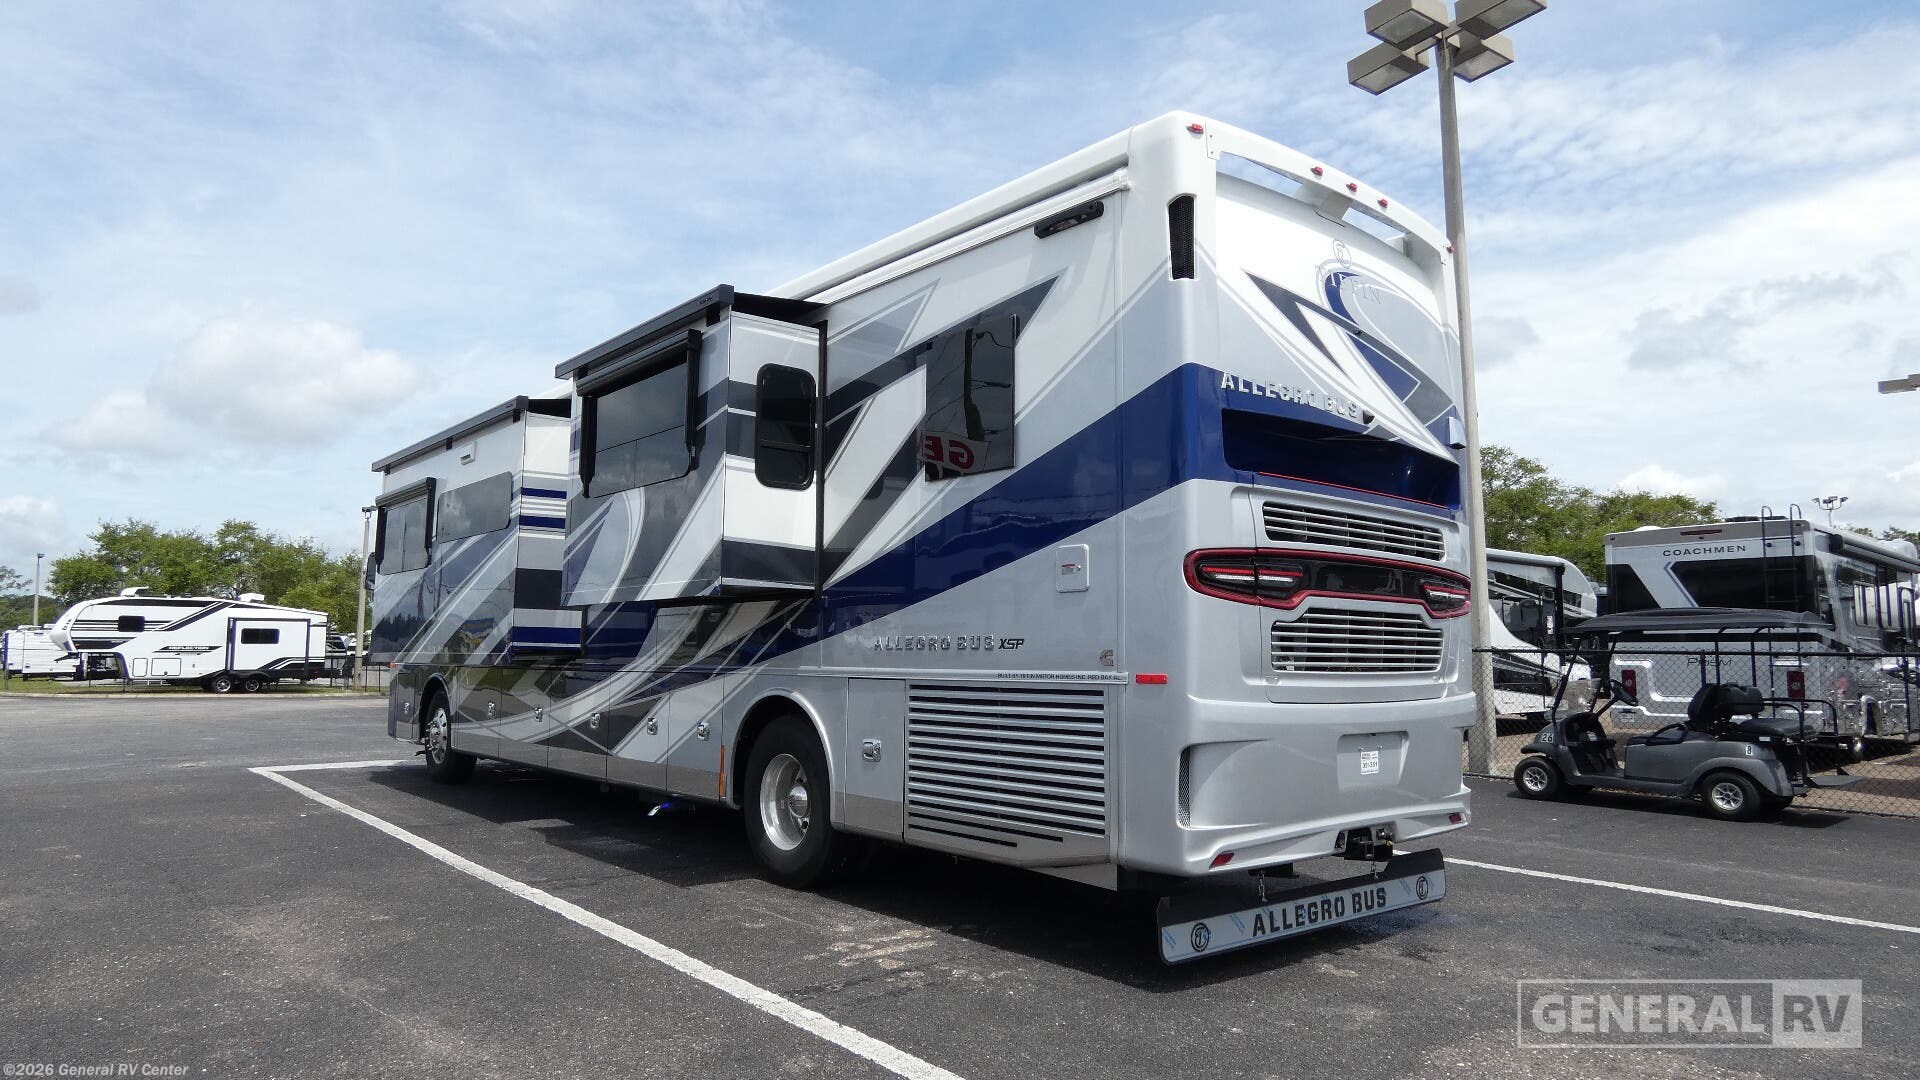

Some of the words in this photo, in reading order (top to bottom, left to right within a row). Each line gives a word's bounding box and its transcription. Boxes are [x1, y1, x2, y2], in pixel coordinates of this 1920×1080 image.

[1221, 371, 1317, 407] ALLEGRO
[1324, 393, 1358, 418] BUS
[1662, 545, 1747, 557] COACHMEN
[874, 634, 951, 651] ALLEGRO
[957, 634, 995, 651] BUS
[998, 638, 1025, 650] XSP
[1542, 733, 1553, 743] 26
[1253, 896, 1345, 937] ALLEGRO
[1352, 887, 1387, 914] BUS
